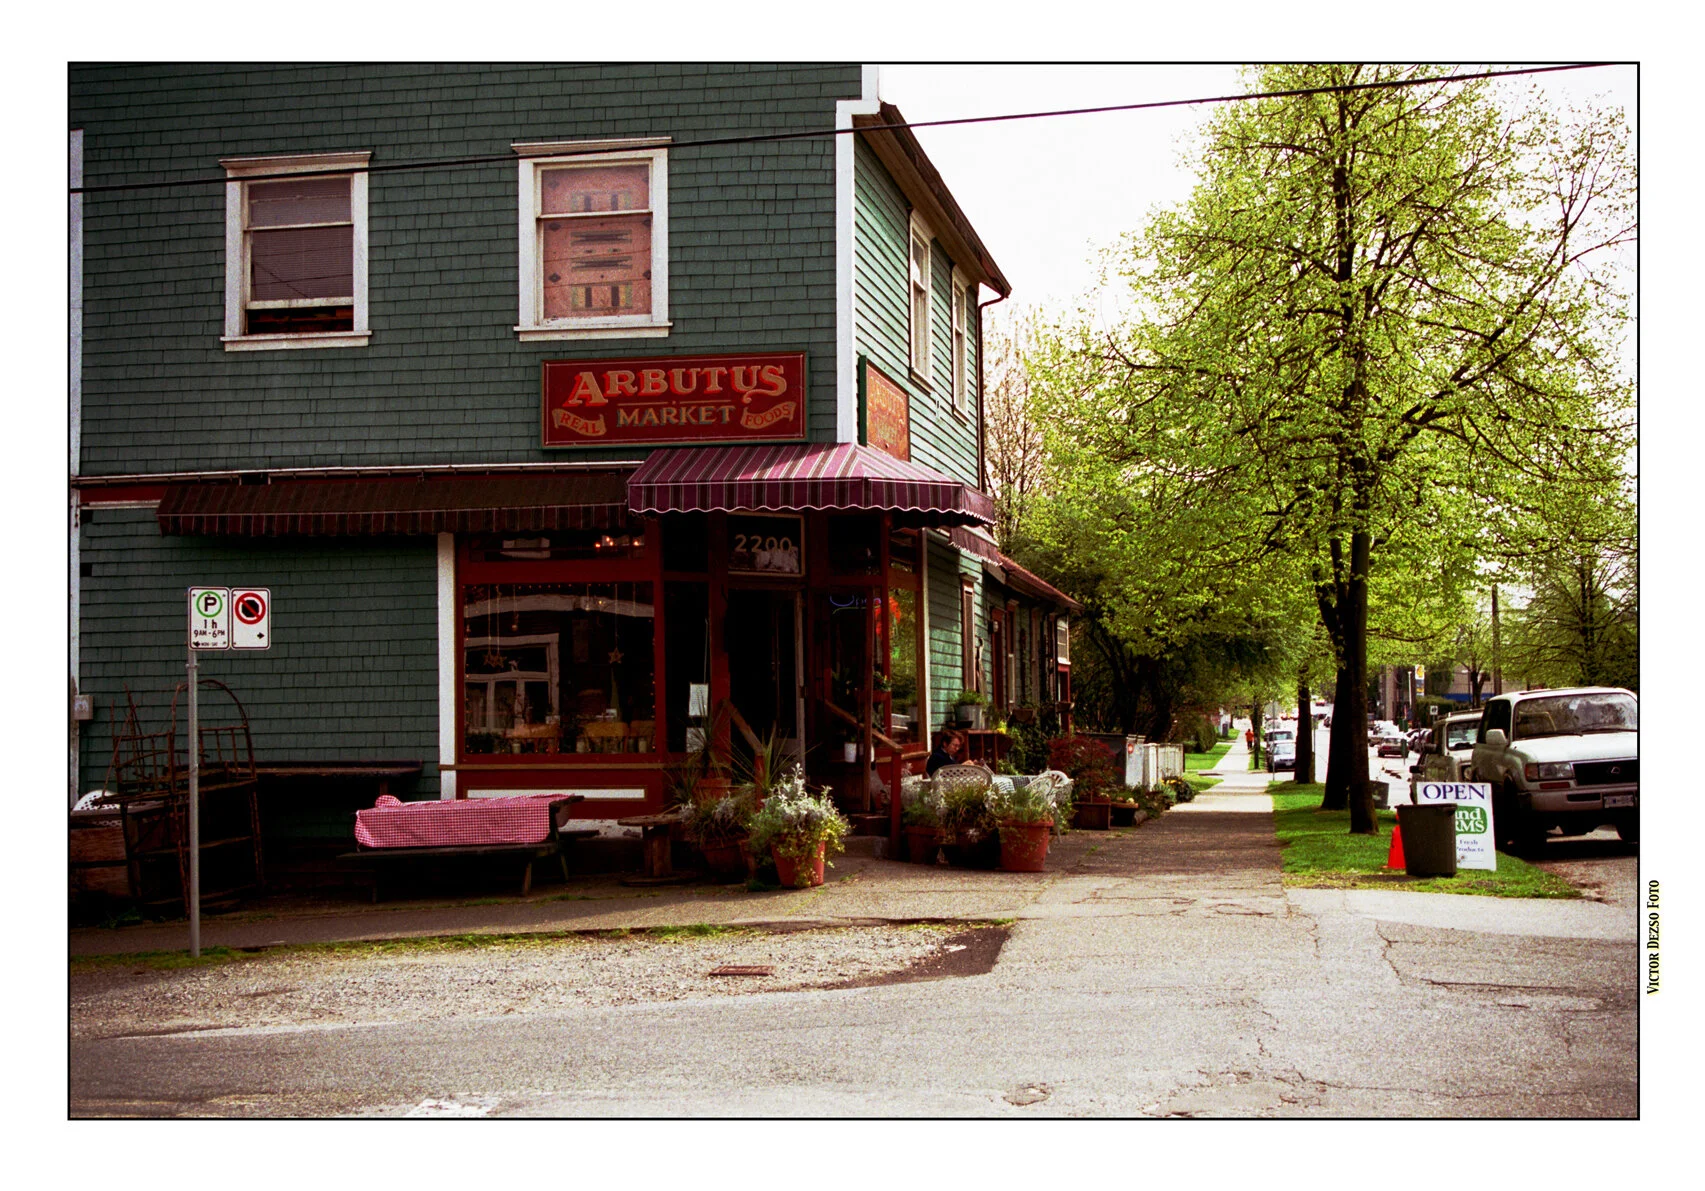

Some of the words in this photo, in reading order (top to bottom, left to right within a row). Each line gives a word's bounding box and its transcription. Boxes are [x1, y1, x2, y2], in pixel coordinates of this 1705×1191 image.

[563, 365, 787, 407] ARBUTUS
[561, 412, 601, 434] REAL
[616, 405, 736, 427] MARKET
[744, 404, 791, 427] FOODS
[735, 534, 793, 553] 2200
[1423, 784, 1485, 799] OPEN
